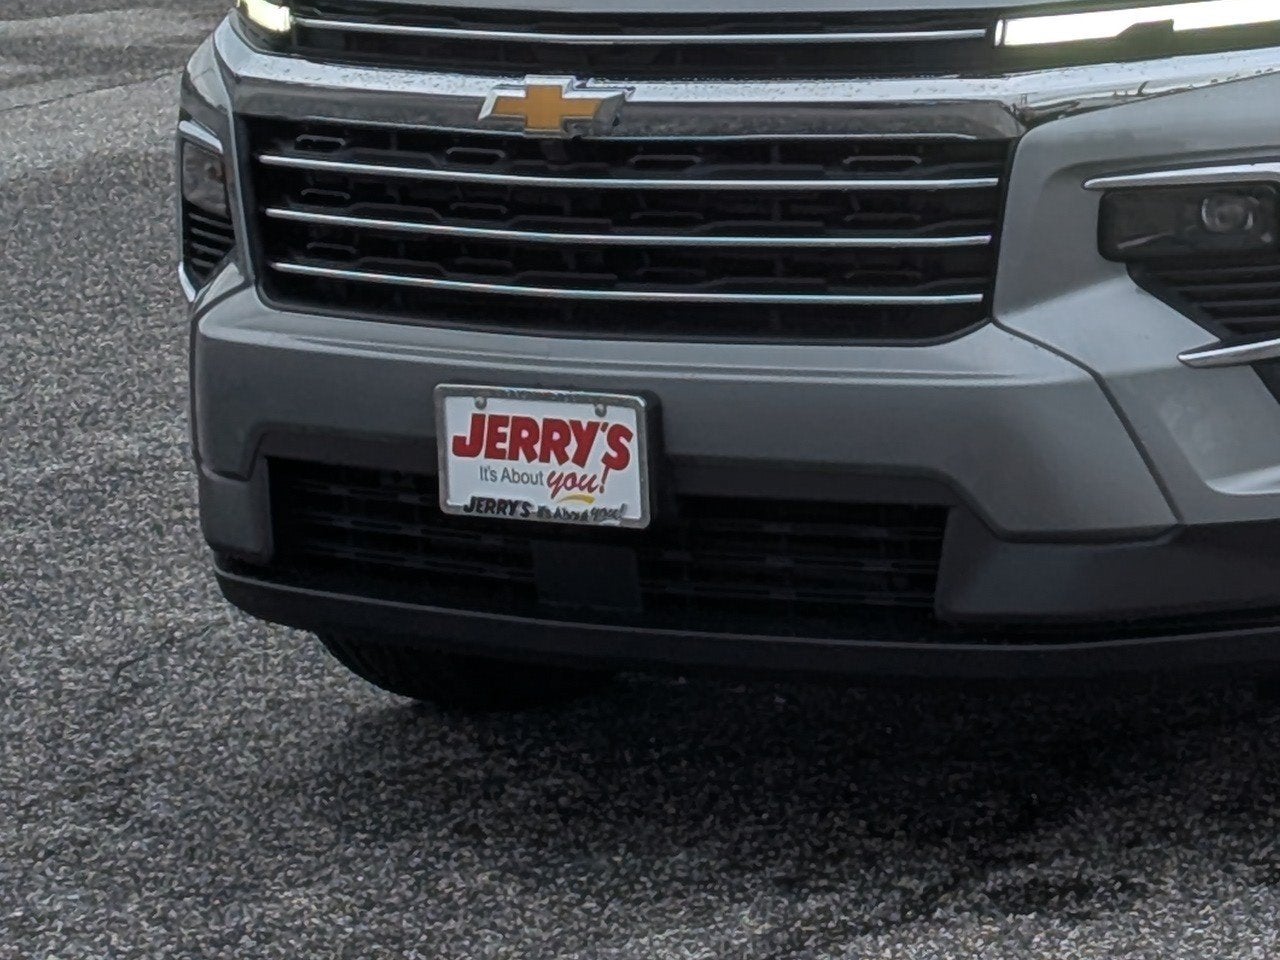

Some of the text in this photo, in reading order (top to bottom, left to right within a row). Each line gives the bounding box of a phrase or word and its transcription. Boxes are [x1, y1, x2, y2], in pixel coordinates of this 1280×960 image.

[452, 413, 633, 471] JERRY'S
[480, 465, 498, 483] It's
[501, 467, 544, 486] About
